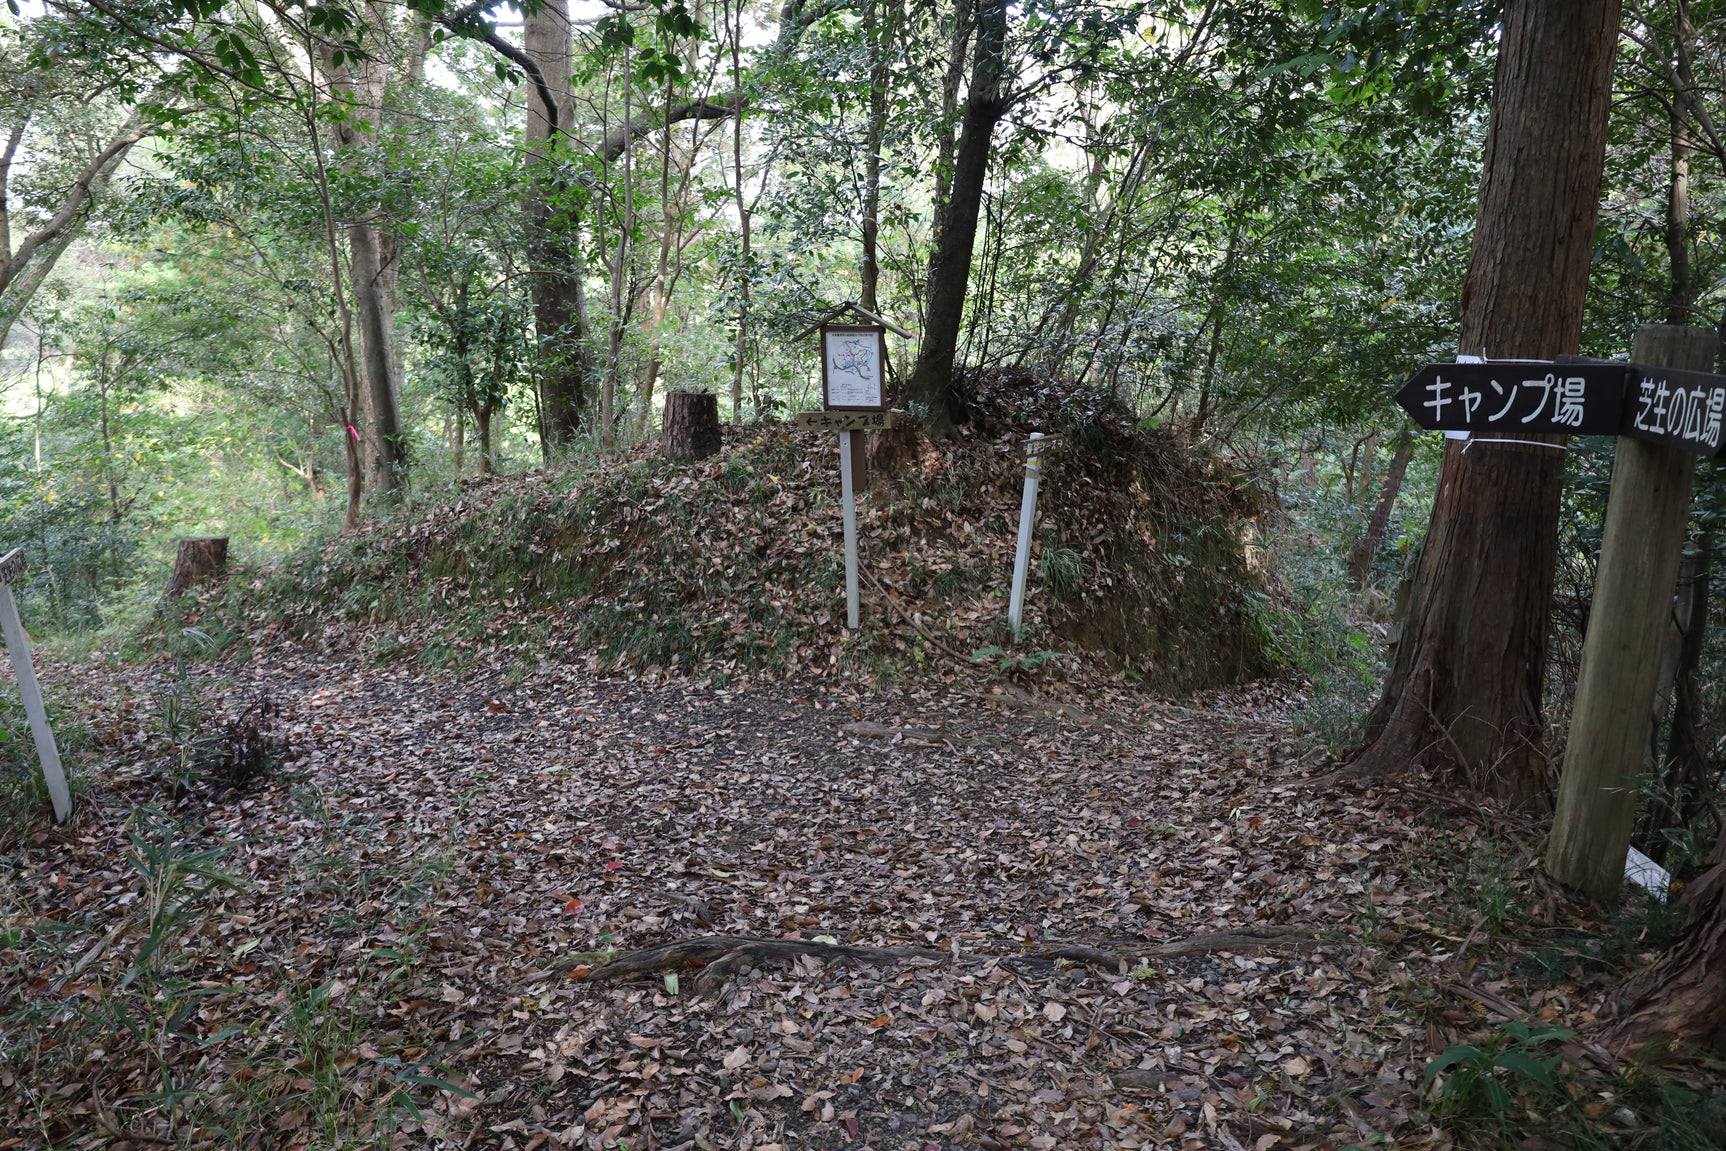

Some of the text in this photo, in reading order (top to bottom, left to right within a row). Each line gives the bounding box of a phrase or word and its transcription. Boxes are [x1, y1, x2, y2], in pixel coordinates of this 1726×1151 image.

[1423, 373, 1586, 427] キャンプ場
[1634, 377, 1726, 448] 芝生の広場
